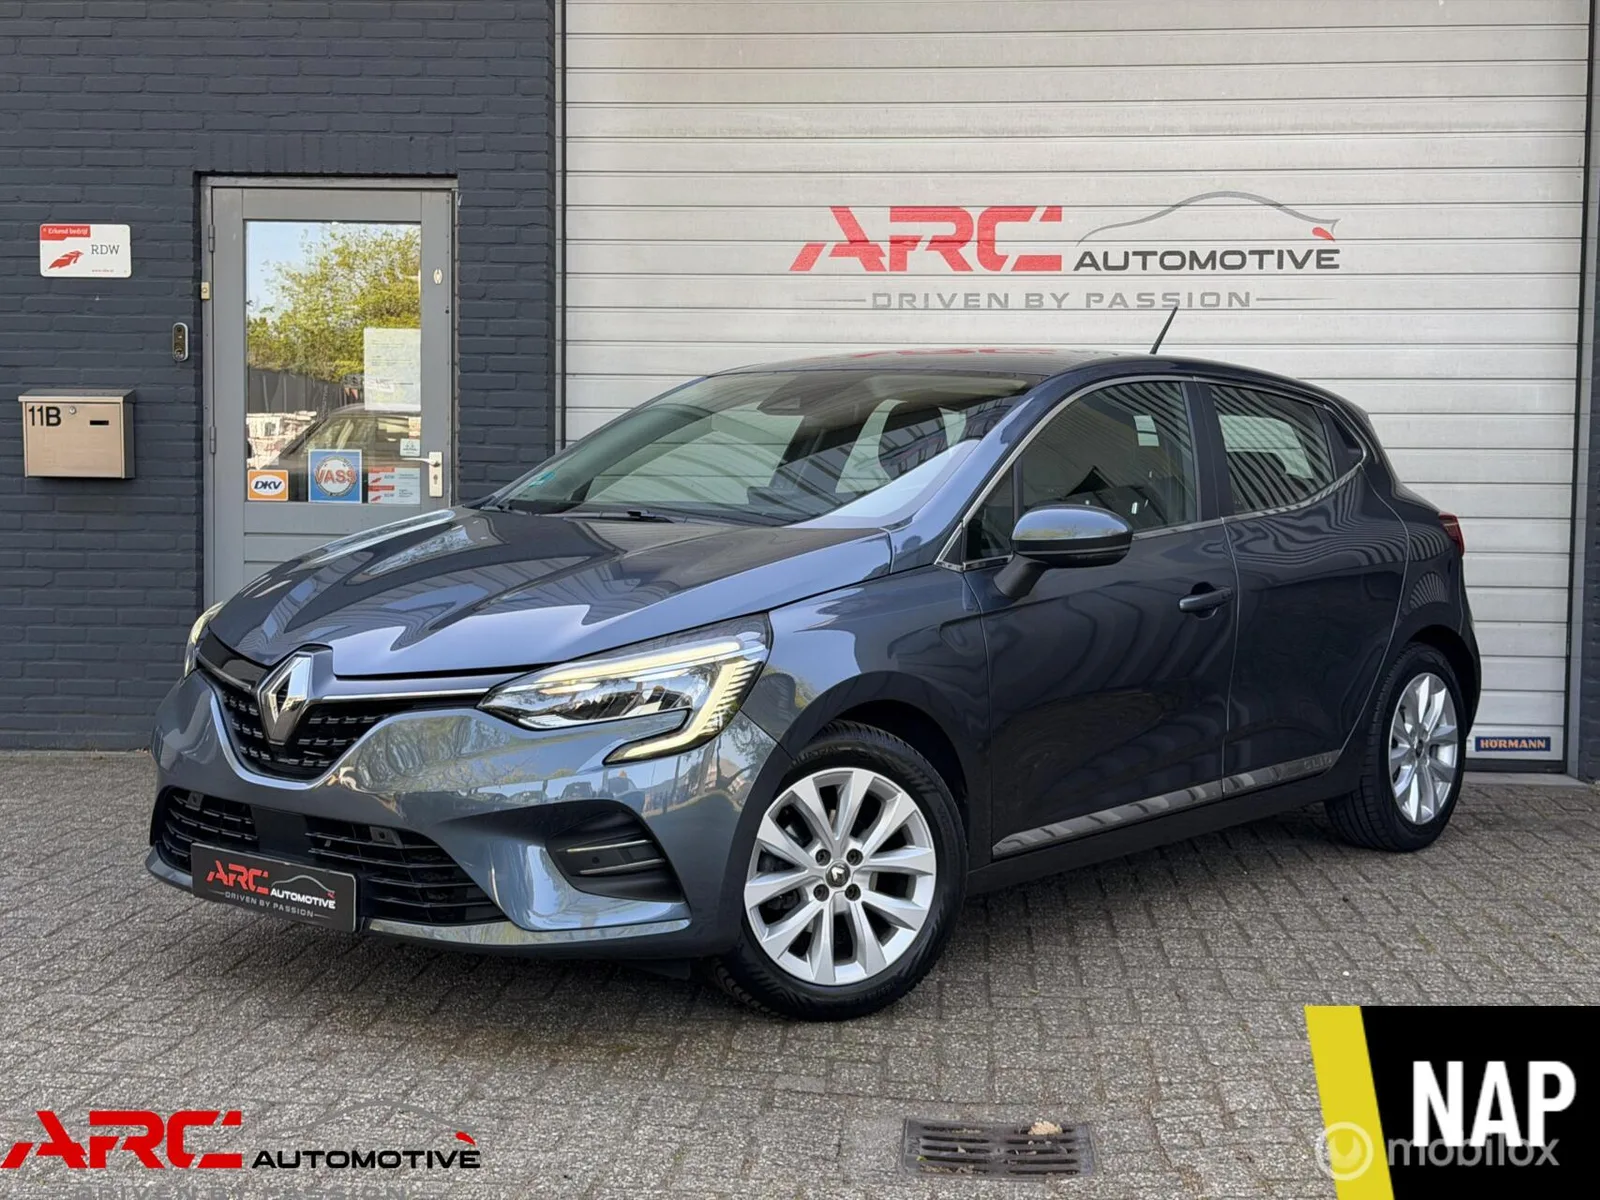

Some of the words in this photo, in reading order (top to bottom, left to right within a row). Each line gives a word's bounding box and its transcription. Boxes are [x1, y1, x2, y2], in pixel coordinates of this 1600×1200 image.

[789, 206, 1063, 272] ARC
[1073, 250, 1340, 271] AUTOMOTIVE
[91, 244, 120, 255] RDW
[871, 293, 1009, 309] DRIVEN
[1025, 292, 1070, 308] BY
[1085, 292, 1251, 308] PASSION
[28, 406, 62, 426] 11B
[254, 480, 282, 490] DKV
[315, 468, 357, 484] VASS
[206, 860, 269, 894] ARC
[270, 888, 336, 909] AUTOMOTIVE
[225, 891, 256, 904] DRIVEN
[259, 900, 270, 908] BY
[273, 904, 314, 917] PASSION
